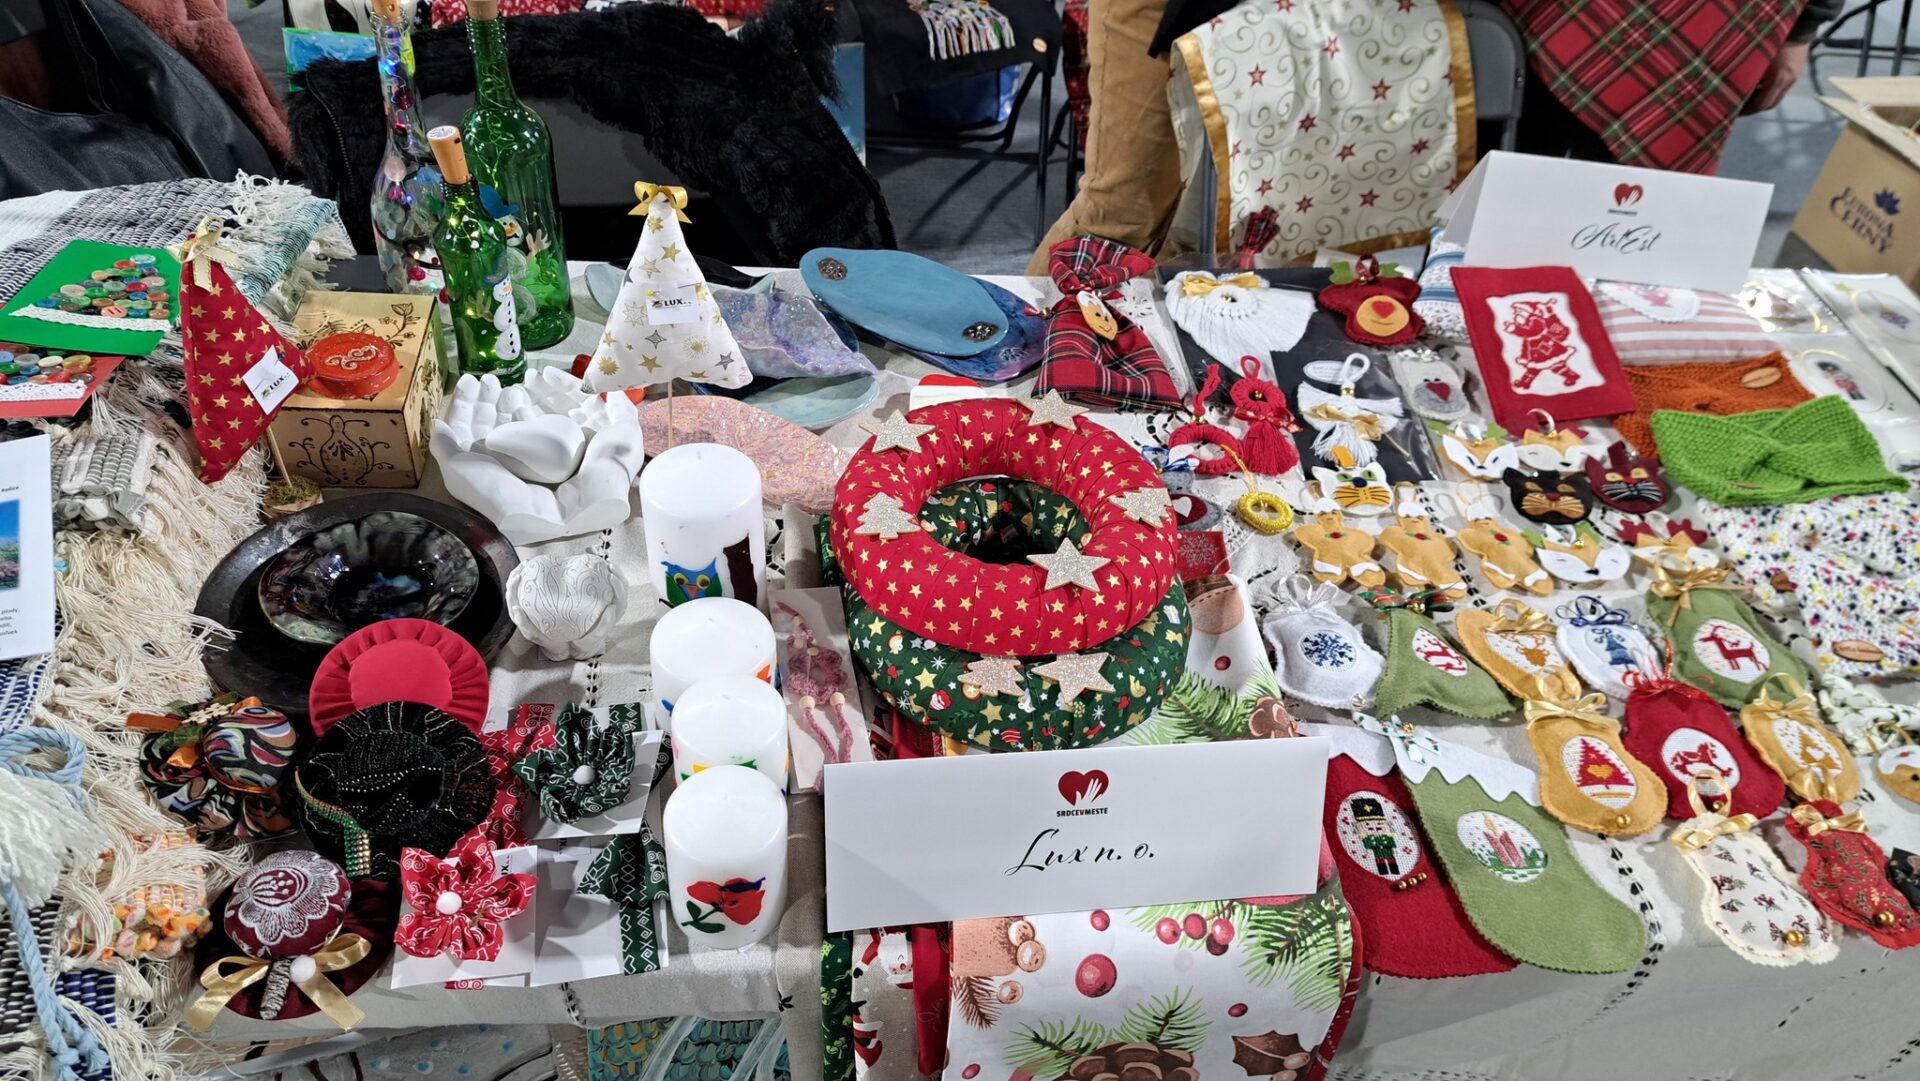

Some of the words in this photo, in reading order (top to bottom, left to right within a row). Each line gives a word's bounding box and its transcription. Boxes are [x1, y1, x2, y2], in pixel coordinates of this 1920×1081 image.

[664, 298, 683, 307] LUX
[269, 375, 285, 390] LUX
[1056, 807, 1108, 818] SRDCEVMESTE
[1004, 828, 1089, 877] Lux
[1094, 846, 1122, 863] n.
[1133, 842, 1155, 859] o.
